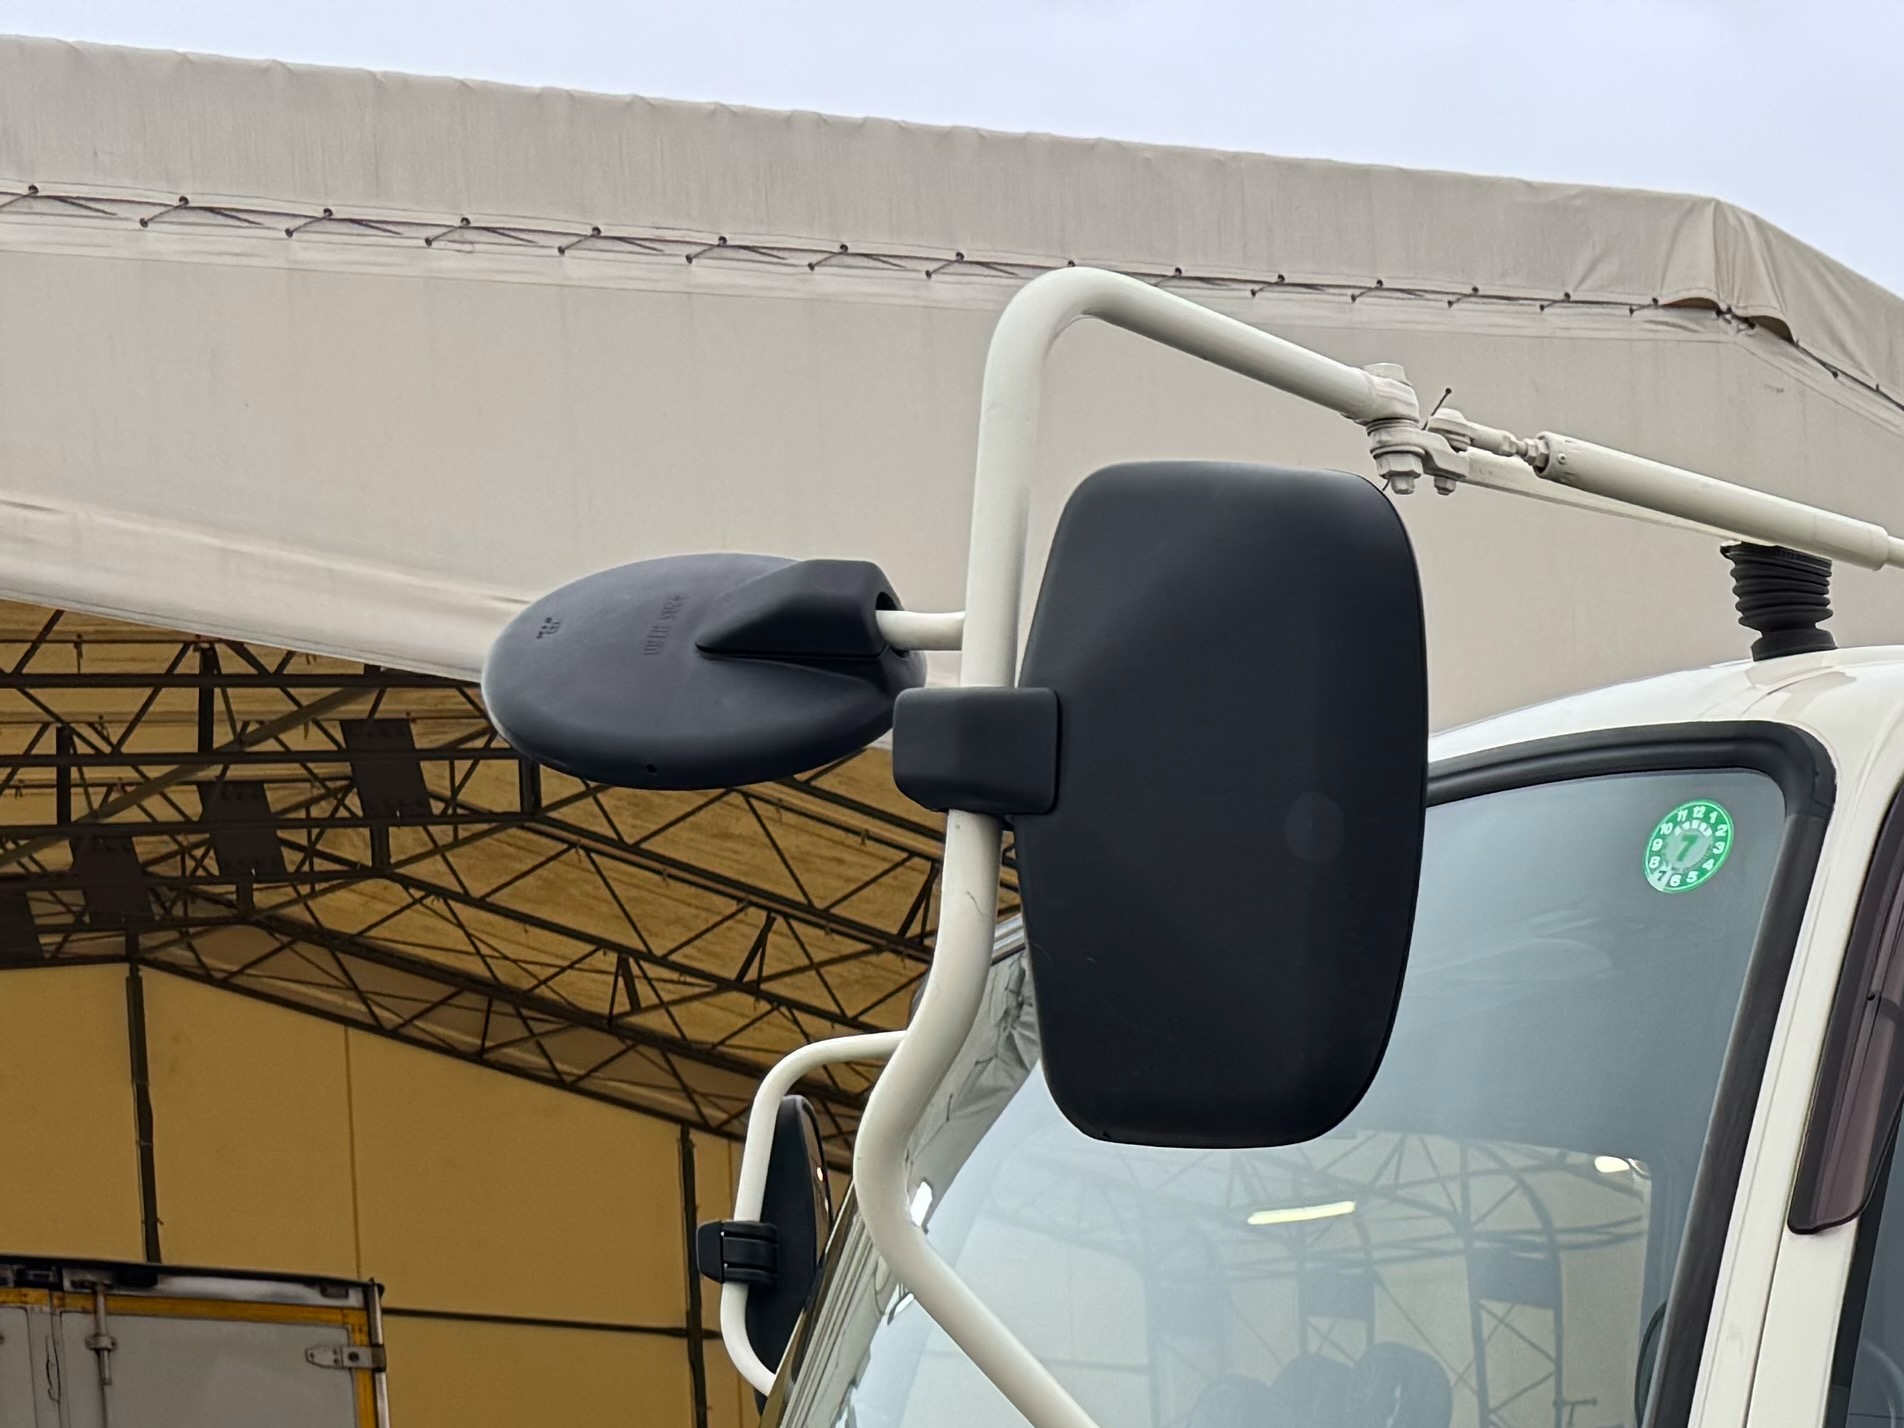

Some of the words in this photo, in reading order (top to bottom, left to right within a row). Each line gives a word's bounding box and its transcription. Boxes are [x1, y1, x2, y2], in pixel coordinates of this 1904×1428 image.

[1677, 809, 1688, 821] 11
[1692, 806, 1706, 818] 12
[1709, 811, 1718, 824] 1
[1660, 822, 1673, 835] 10
[1715, 824, 1728, 836] 2
[1651, 838, 1663, 851] 9
[1676, 833, 1700, 862] 7
[1712, 841, 1725, 854] 3
[1649, 856, 1660, 868] 8
[1702, 859, 1714, 870] 4
[1657, 870, 1667, 881] 7
[1670, 874, 1681, 887] 6
[1686, 871, 1698, 883] 5
